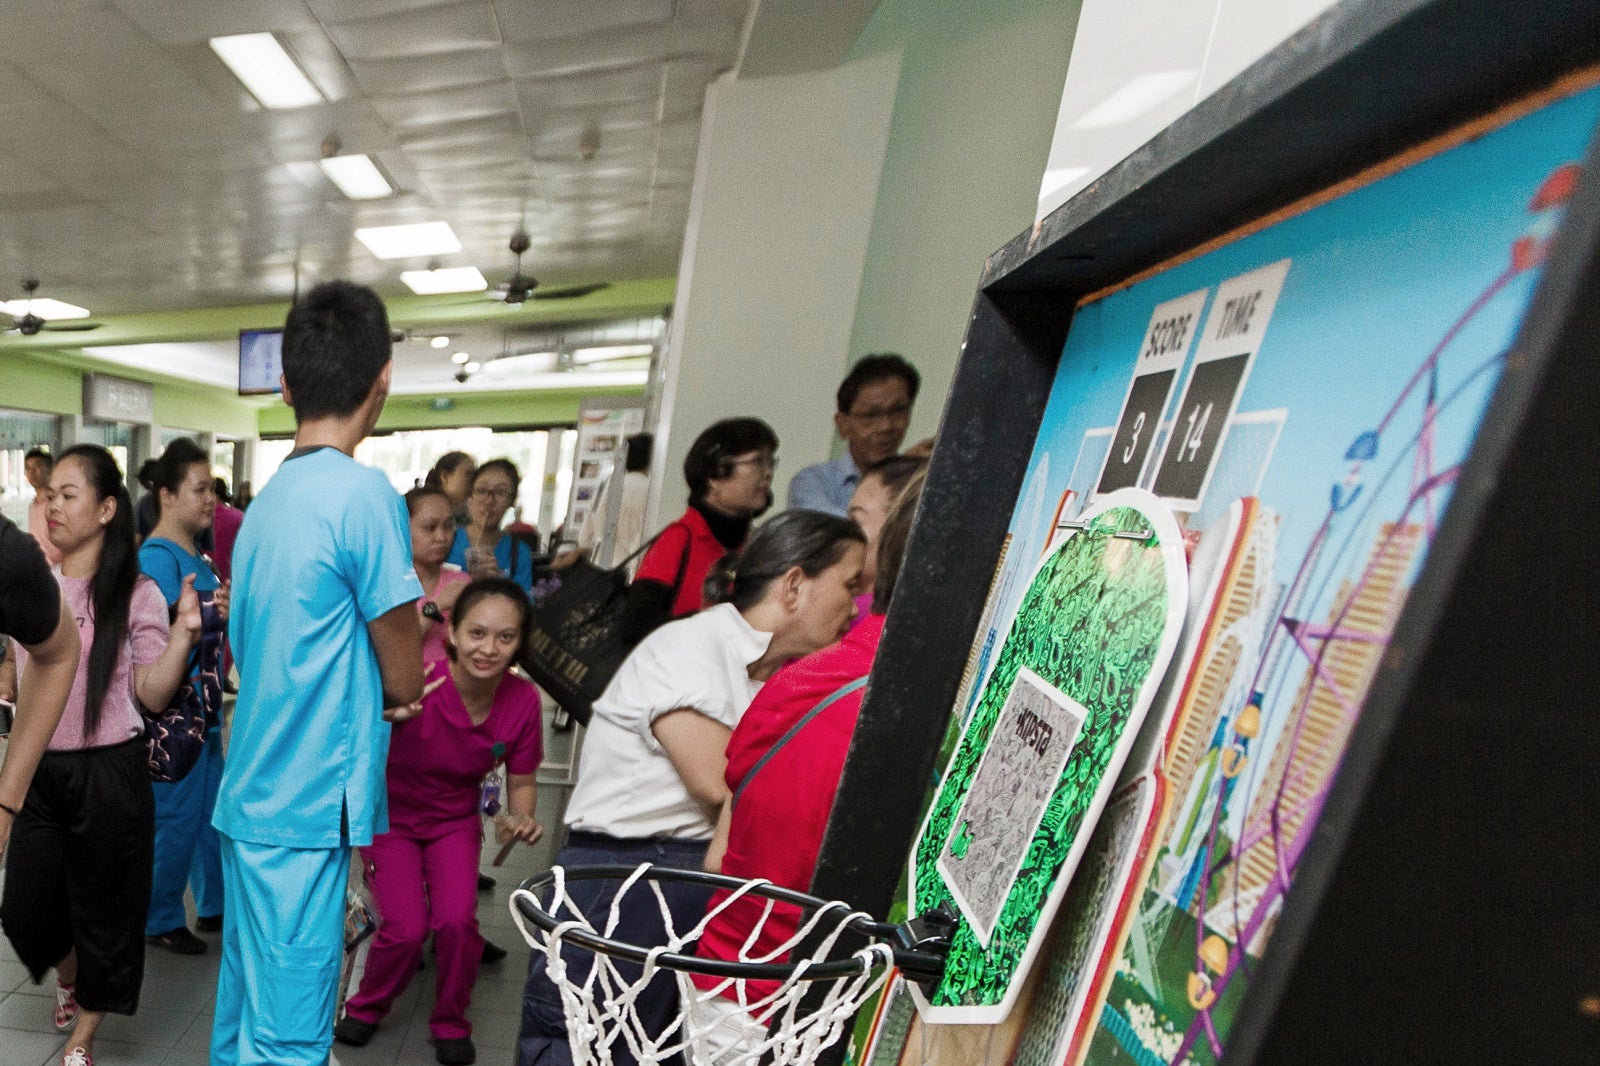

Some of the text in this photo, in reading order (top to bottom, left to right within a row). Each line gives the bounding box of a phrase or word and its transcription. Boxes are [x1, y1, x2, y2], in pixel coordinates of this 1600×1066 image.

[1145, 312, 1193, 360] SCORE
[1215, 290, 1264, 341] TIME
[1123, 411, 1146, 464] 3
[1177, 402, 1214, 462] 14
